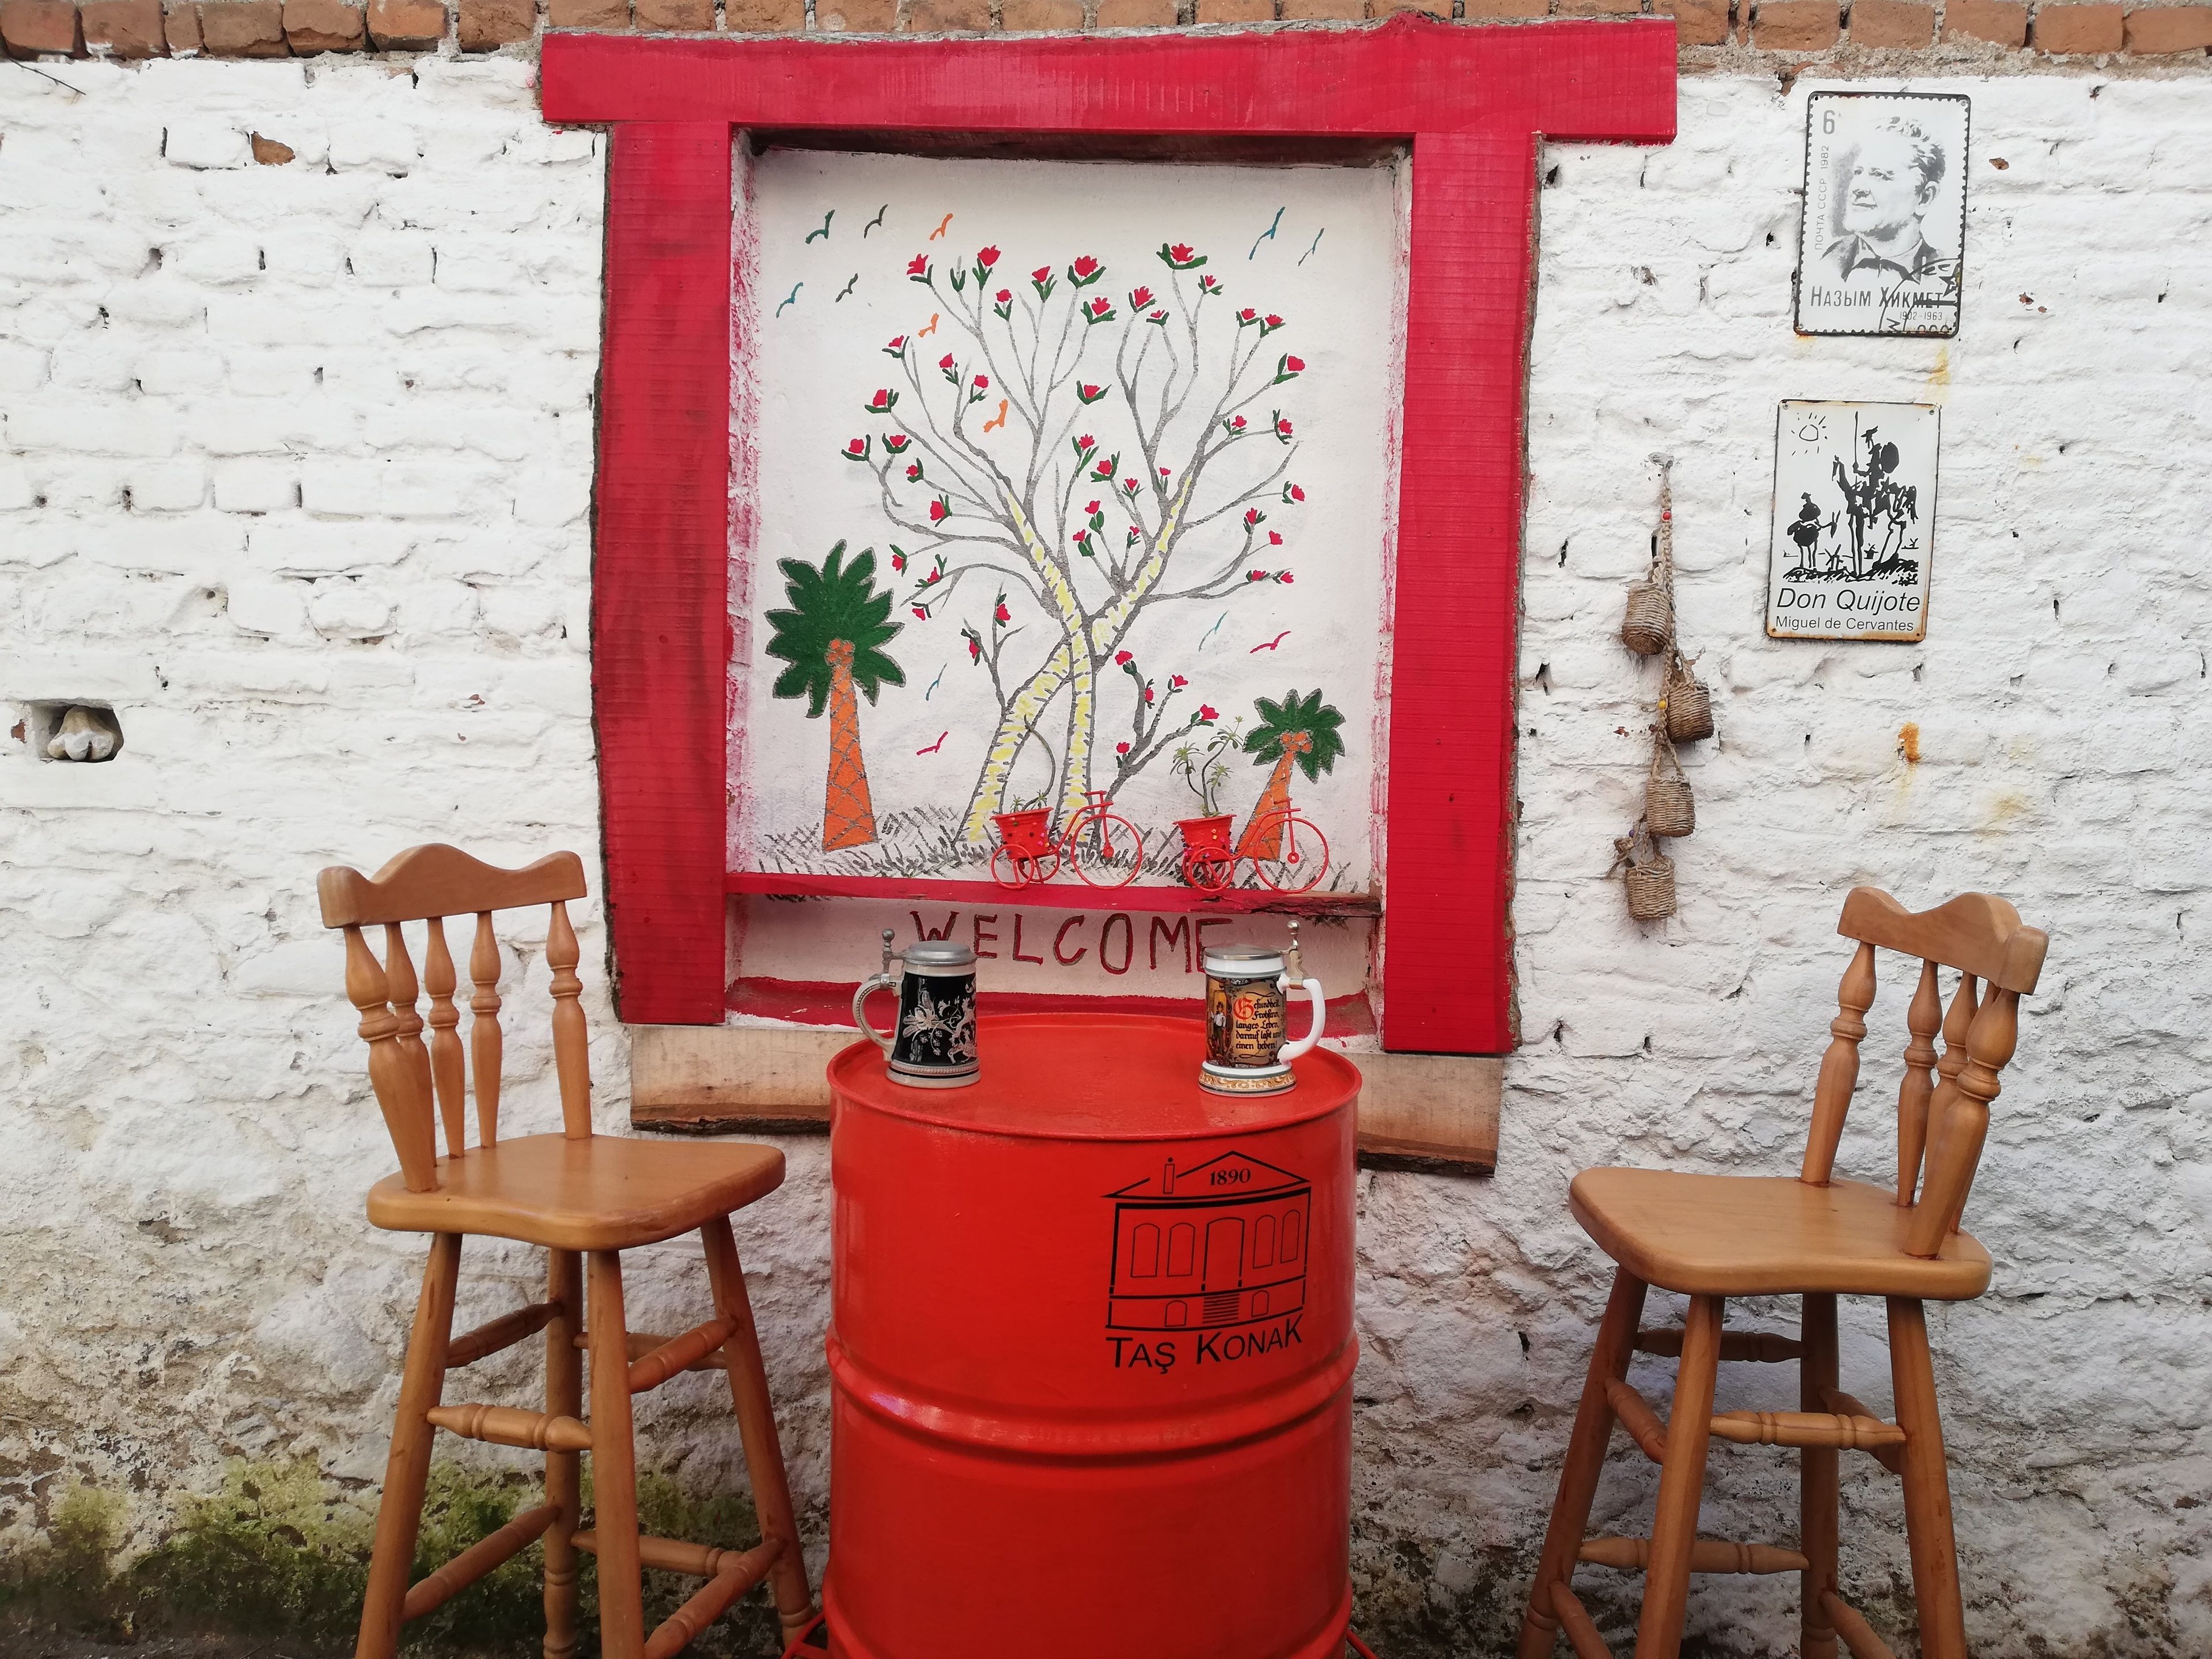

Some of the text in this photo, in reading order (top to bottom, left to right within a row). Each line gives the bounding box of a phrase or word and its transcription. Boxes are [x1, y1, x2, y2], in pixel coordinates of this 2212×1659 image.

[1823, 109, 1835, 135] 6
[1815, 145, 1830, 250] ПОЧТА СССР 1982
[1776, 588, 1920, 616] Don Quijote
[1775, 616, 1914, 631] Miguel de Cervantes
[1236, 1020, 1259, 1032] langes
[1236, 1041, 1254, 1050] einen
[1210, 1168, 1251, 1186] 1890
[1105, 1313, 1304, 1375] TAŞ KONAK
